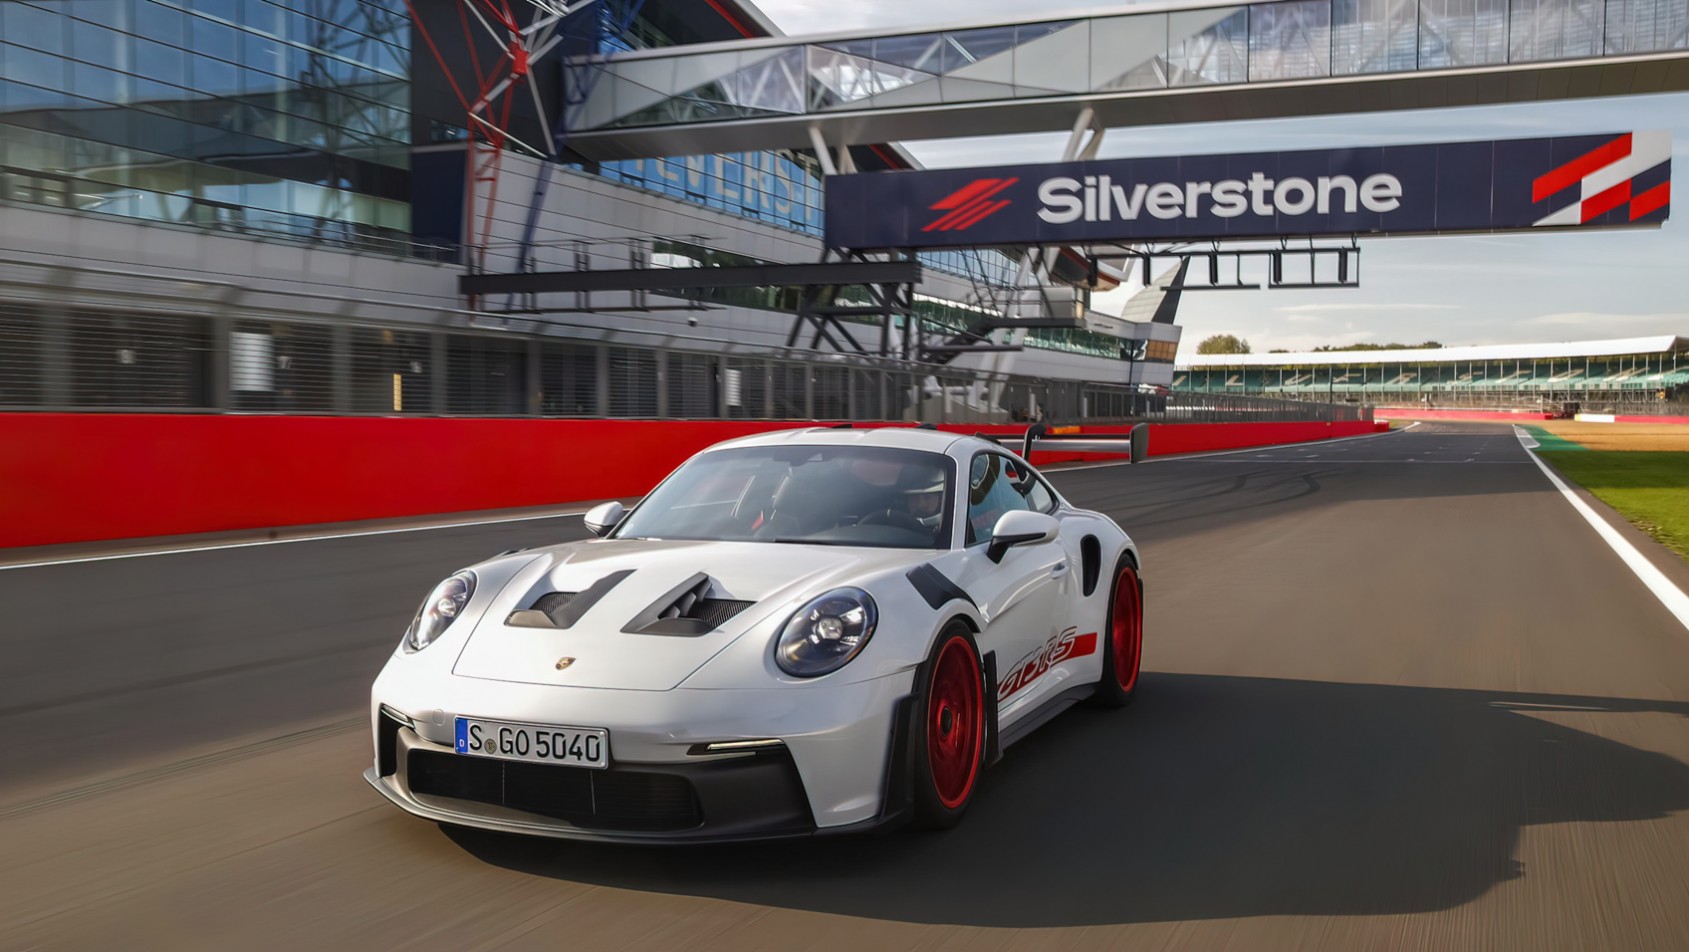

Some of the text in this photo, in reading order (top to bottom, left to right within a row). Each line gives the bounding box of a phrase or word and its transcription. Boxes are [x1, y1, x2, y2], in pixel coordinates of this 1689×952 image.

[1037, 172, 1402, 224] Silverstone
[469, 724, 601, 762] S GO 5040
